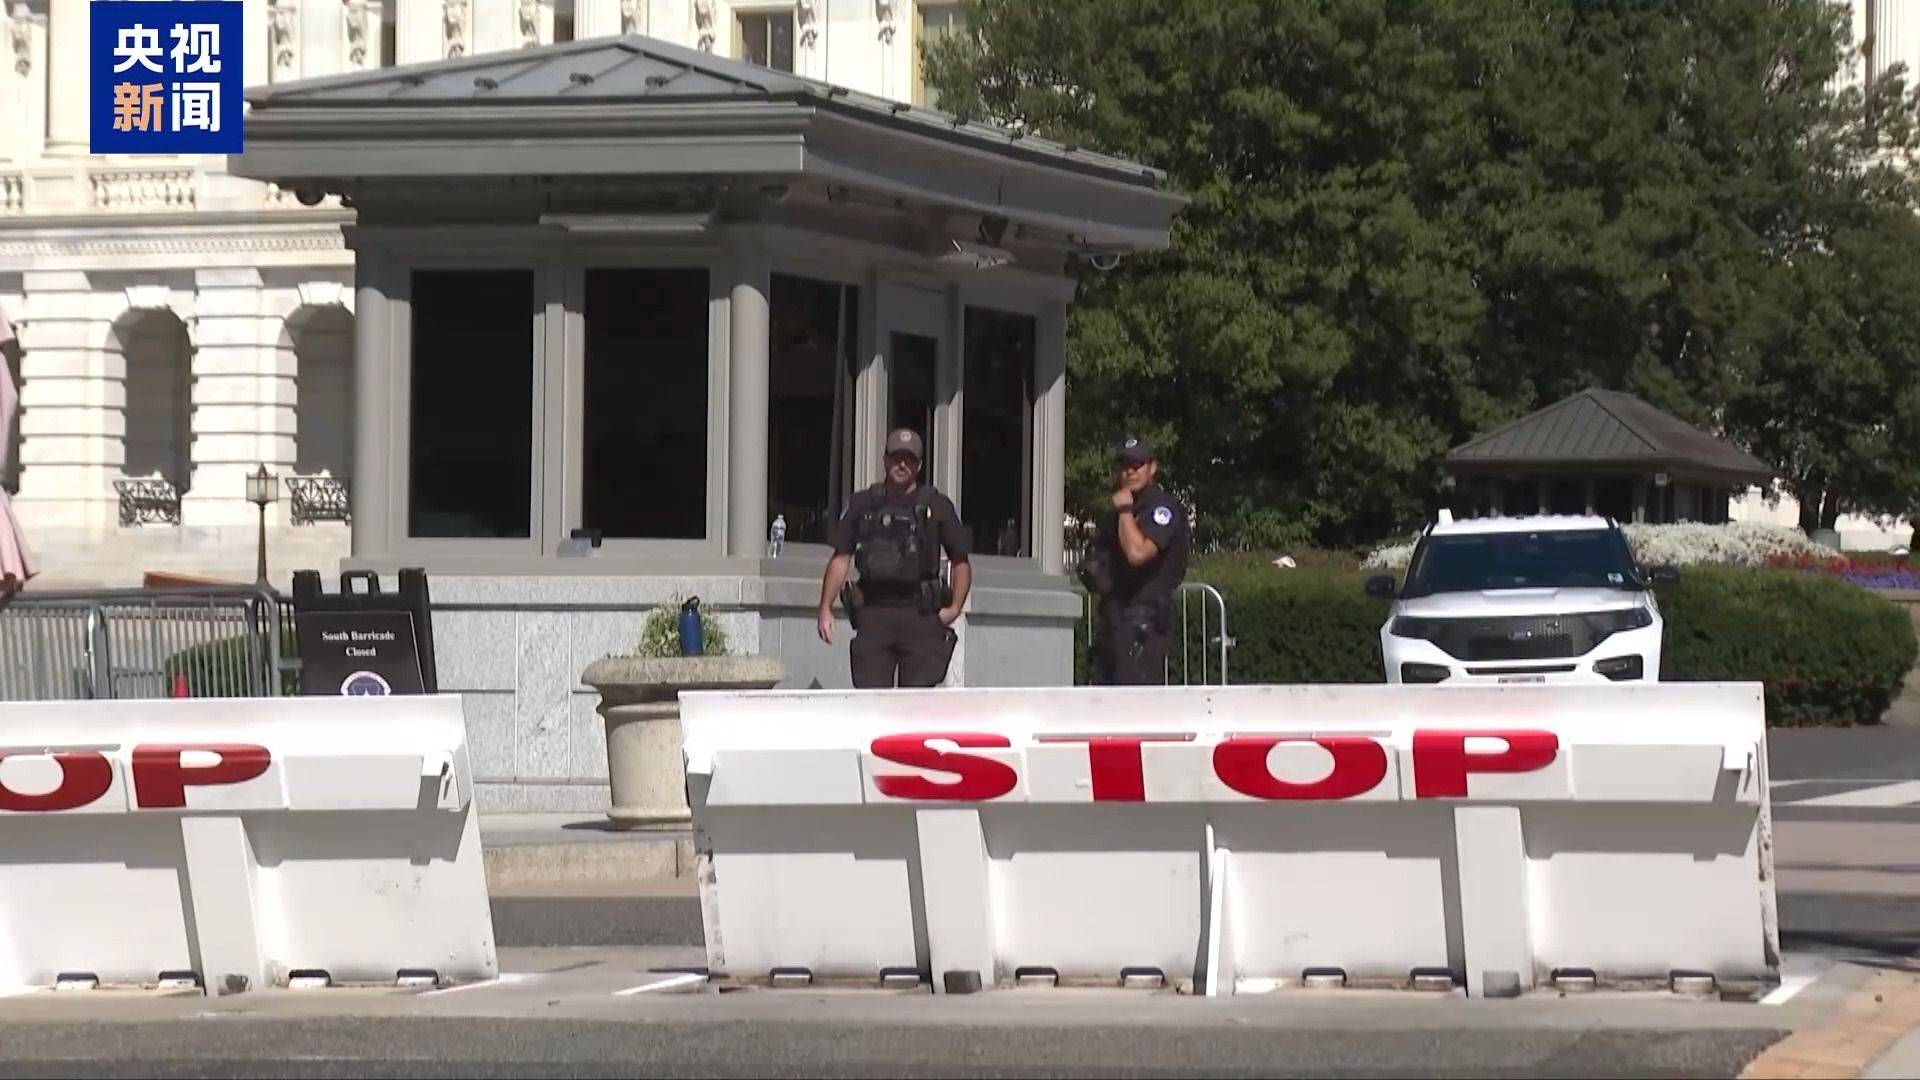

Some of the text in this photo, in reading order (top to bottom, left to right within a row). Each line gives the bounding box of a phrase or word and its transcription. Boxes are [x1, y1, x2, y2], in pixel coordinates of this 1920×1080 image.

[322, 630, 395, 641] South Barricade
[346, 647, 376, 657] Closed
[870, 729, 1559, 802] STOP
